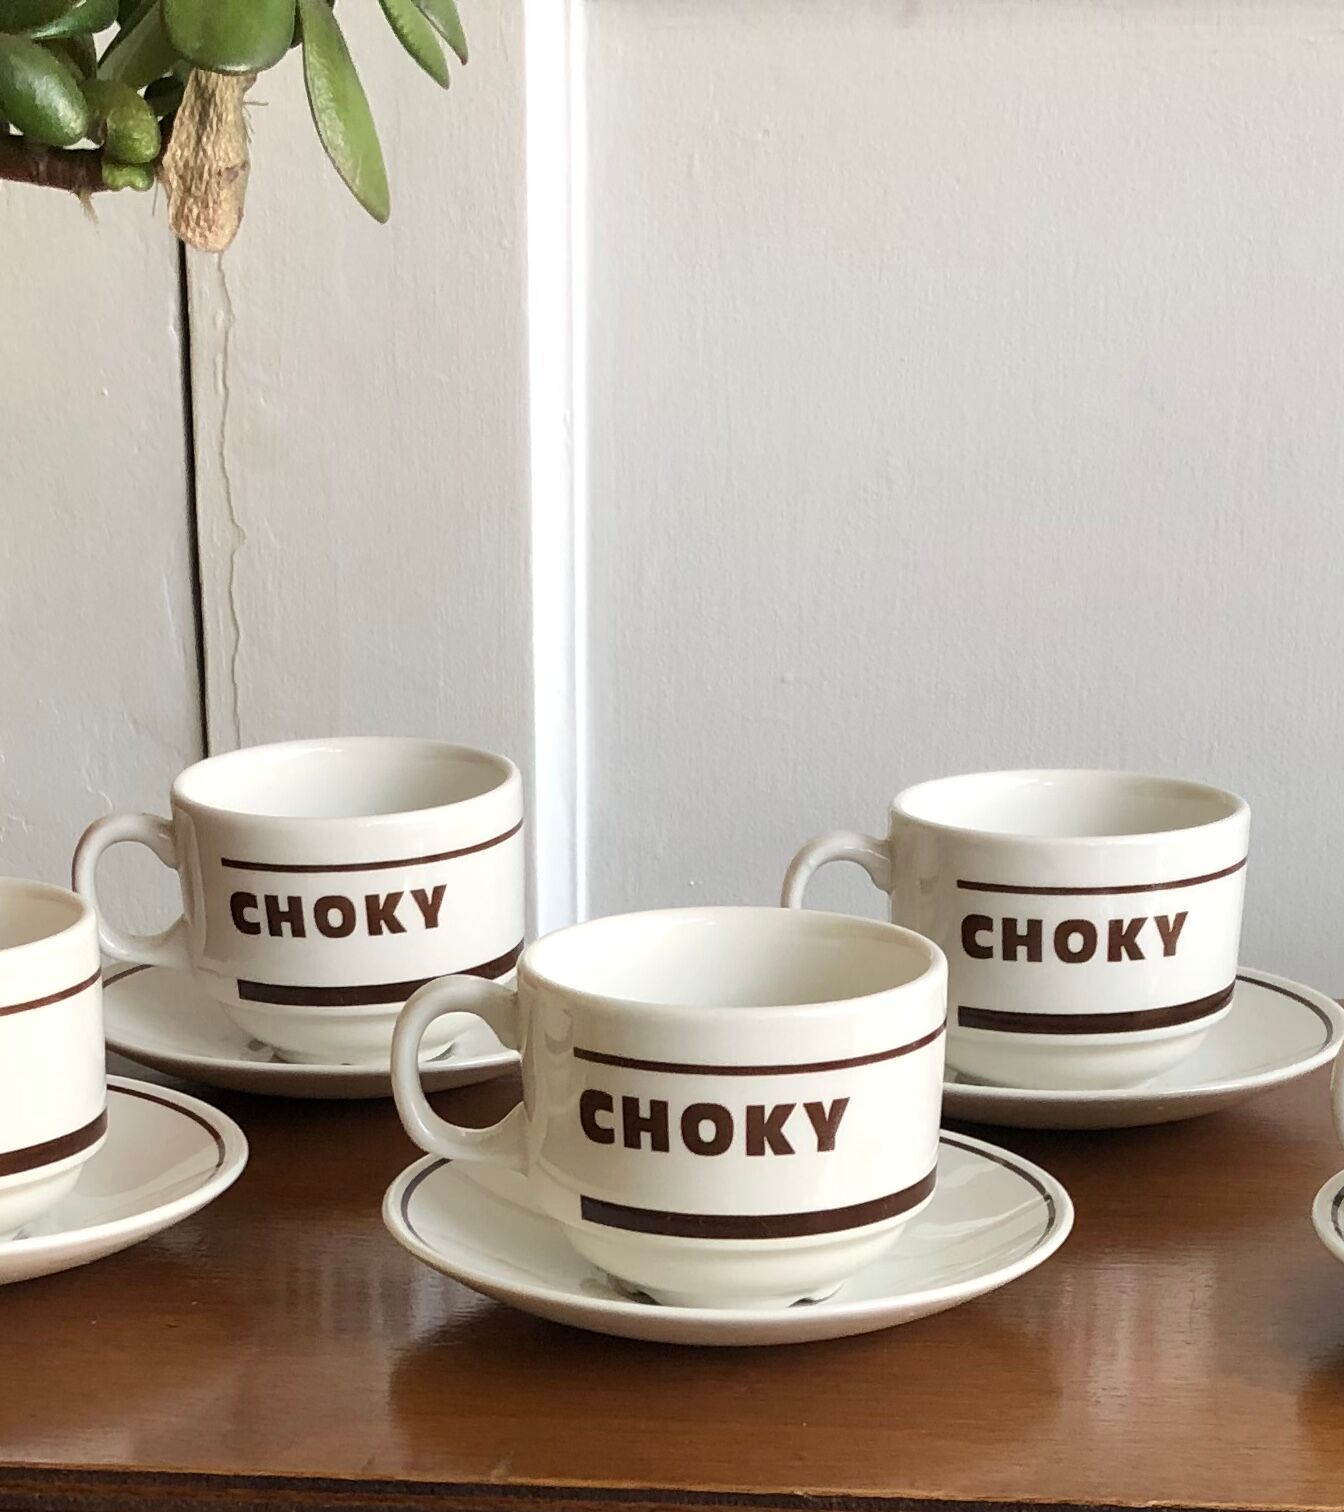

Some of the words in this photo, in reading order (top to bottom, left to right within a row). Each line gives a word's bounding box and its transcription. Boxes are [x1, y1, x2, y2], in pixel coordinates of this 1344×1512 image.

[230, 885, 447, 939] CHOKY
[960, 911, 1189, 964] CHOKY
[579, 1086, 850, 1157] CHOKY
